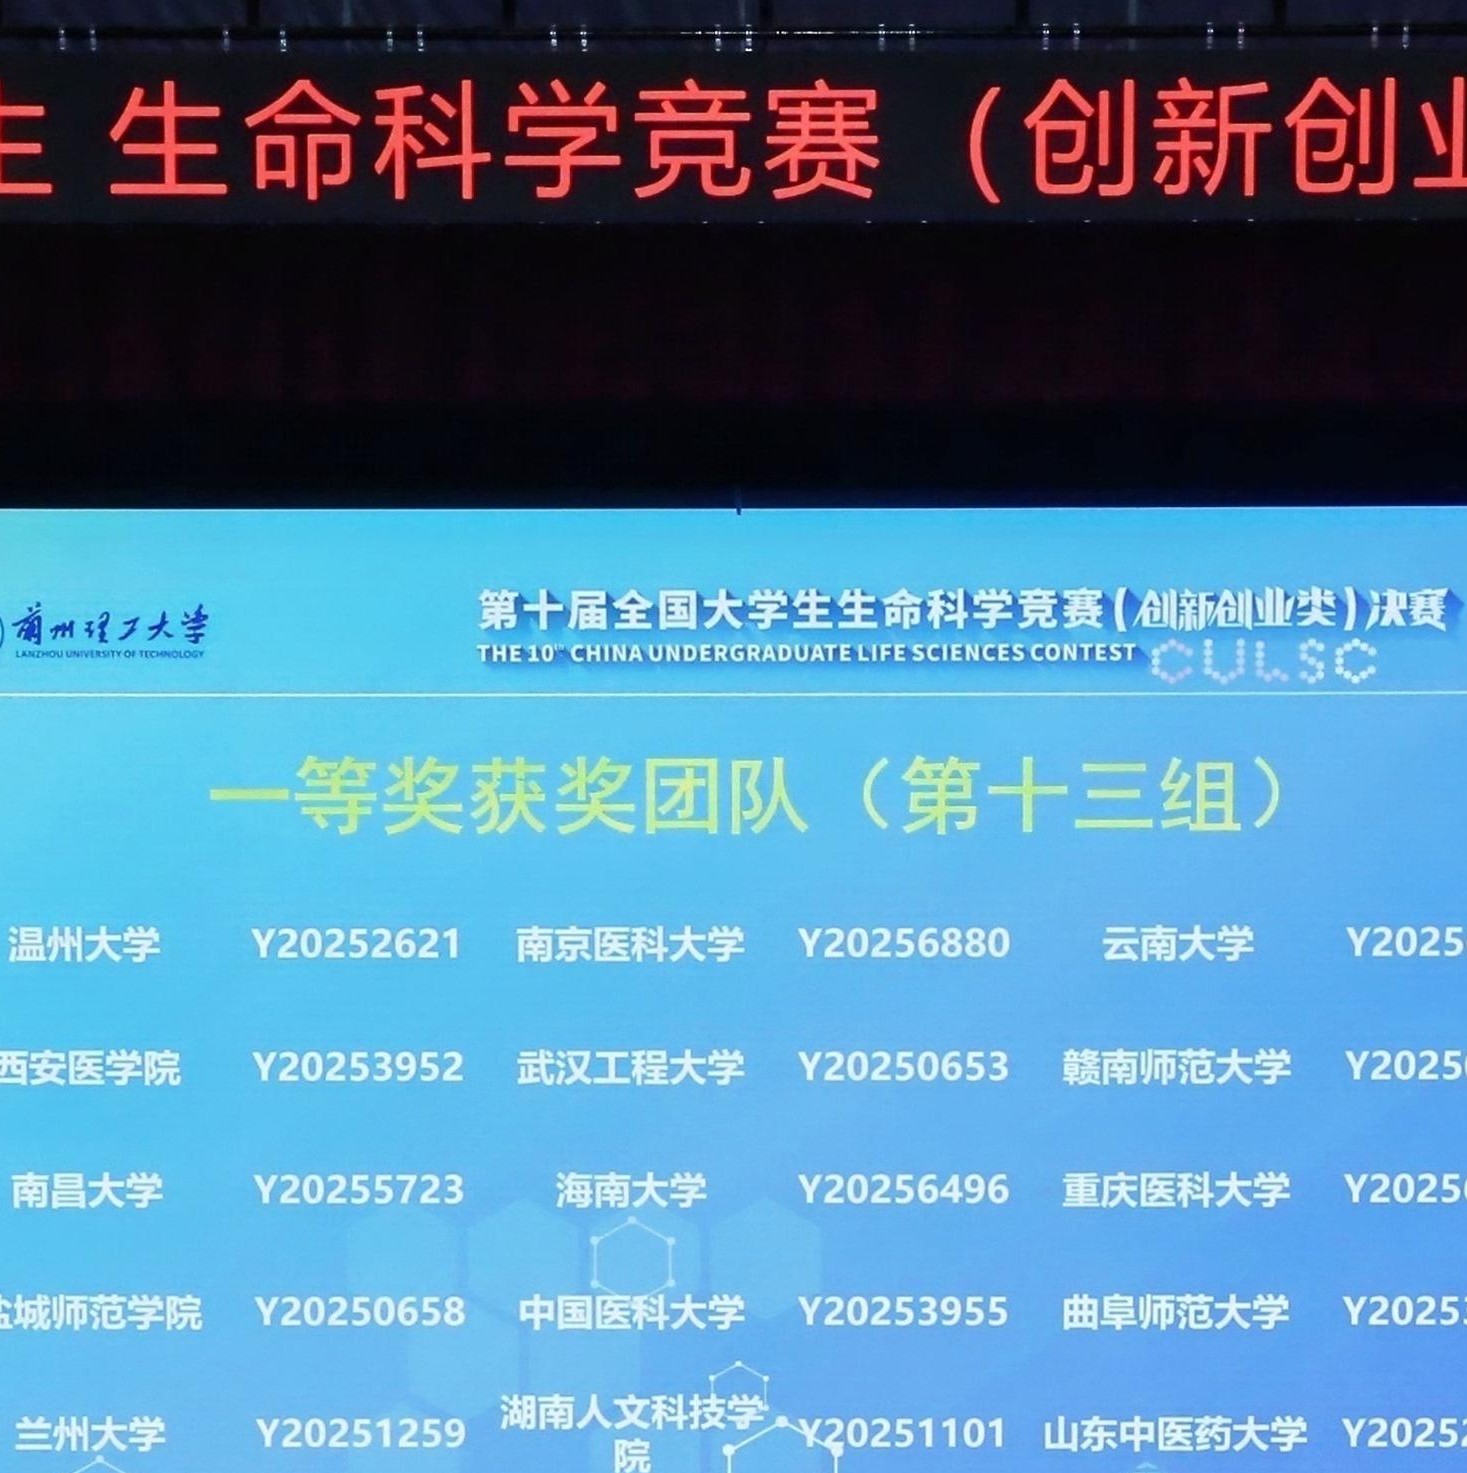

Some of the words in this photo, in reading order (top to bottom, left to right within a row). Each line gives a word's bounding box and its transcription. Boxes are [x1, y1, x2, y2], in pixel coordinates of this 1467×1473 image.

[15, 650, 64, 659] LANZHOU
[66, 650, 122, 659] UNIVERSITY
[124, 650, 136, 659] OF
[139, 650, 205, 659] TECHNOLOGY
[477, 644, 522, 663] THE
[570, 644, 643, 663] CHINA
[649, 644, 851, 663] UNDERGRADUATE
[857, 644, 906, 663] LIFE
[912, 644, 1025, 663] SCIENCES
[1031, 644, 1137, 663] CONTEST
[1151, 638, 1377, 685] CULSC
[210, 755, 1281, 836] 一等奖获奖团队（第十三组）
[9, 926, 160, 962] 温州大学
[252, 928, 458, 958] Y20252621
[517, 926, 744, 962] 南京医科大学
[799, 928, 1010, 957] Y20256880
[1103, 925, 1254, 961] 云南大学
[253, 1052, 463, 1081] Y20253952
[518, 1049, 744, 1085] 武汉工程大学
[798, 1051, 1009, 1081] Y20250653
[1063, 1048, 1291, 1085] 赣南师范大学
[12, 1172, 162, 1208] 南昌大学
[254, 1174, 463, 1204] Y20255723
[557, 1172, 706, 1208] 海南大学
[798, 1174, 1009, 1203] Y20256496
[1063, 1172, 1290, 1207] 重庆医科大学
[256, 1297, 465, 1326] Y20250658
[520, 1294, 744, 1330] 中国医科大学
[798, 1296, 1008, 1325] Y20253955
[1064, 1294, 1289, 1330] 曲阜师范大学
[501, 1393, 763, 1431] 湖南人文科技学
[16, 1416, 165, 1452] 兰州大学
[257, 1418, 465, 1447] Y20251259
[799, 1418, 1003, 1447] Y20251101
[1045, 1416, 1307, 1452] 山东中医药大学
